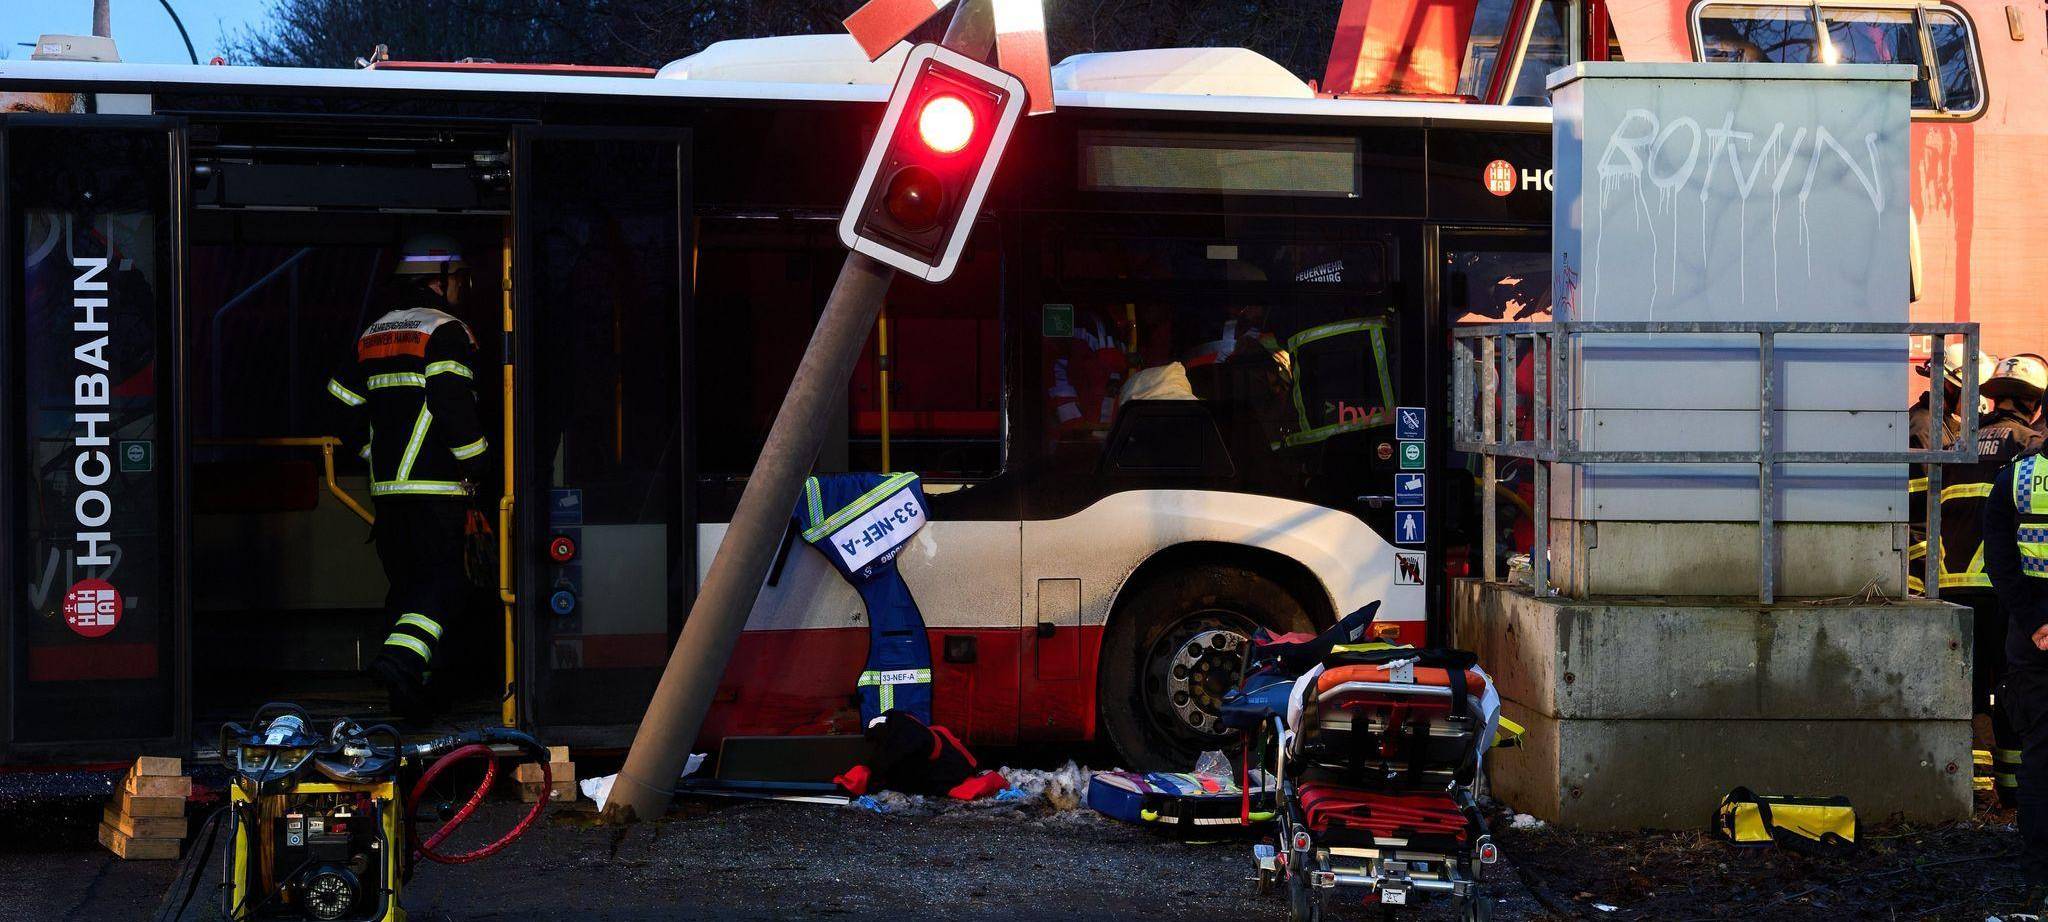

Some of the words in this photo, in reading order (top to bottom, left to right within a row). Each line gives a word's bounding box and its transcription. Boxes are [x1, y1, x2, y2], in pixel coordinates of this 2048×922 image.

[1295, 260, 1344, 282] FEUERWEHR
[73, 257, 112, 566] HOCHBAHN
[841, 501, 918, 557] 33-NEF-A
[882, 673, 915, 682] 33-NEF-A
